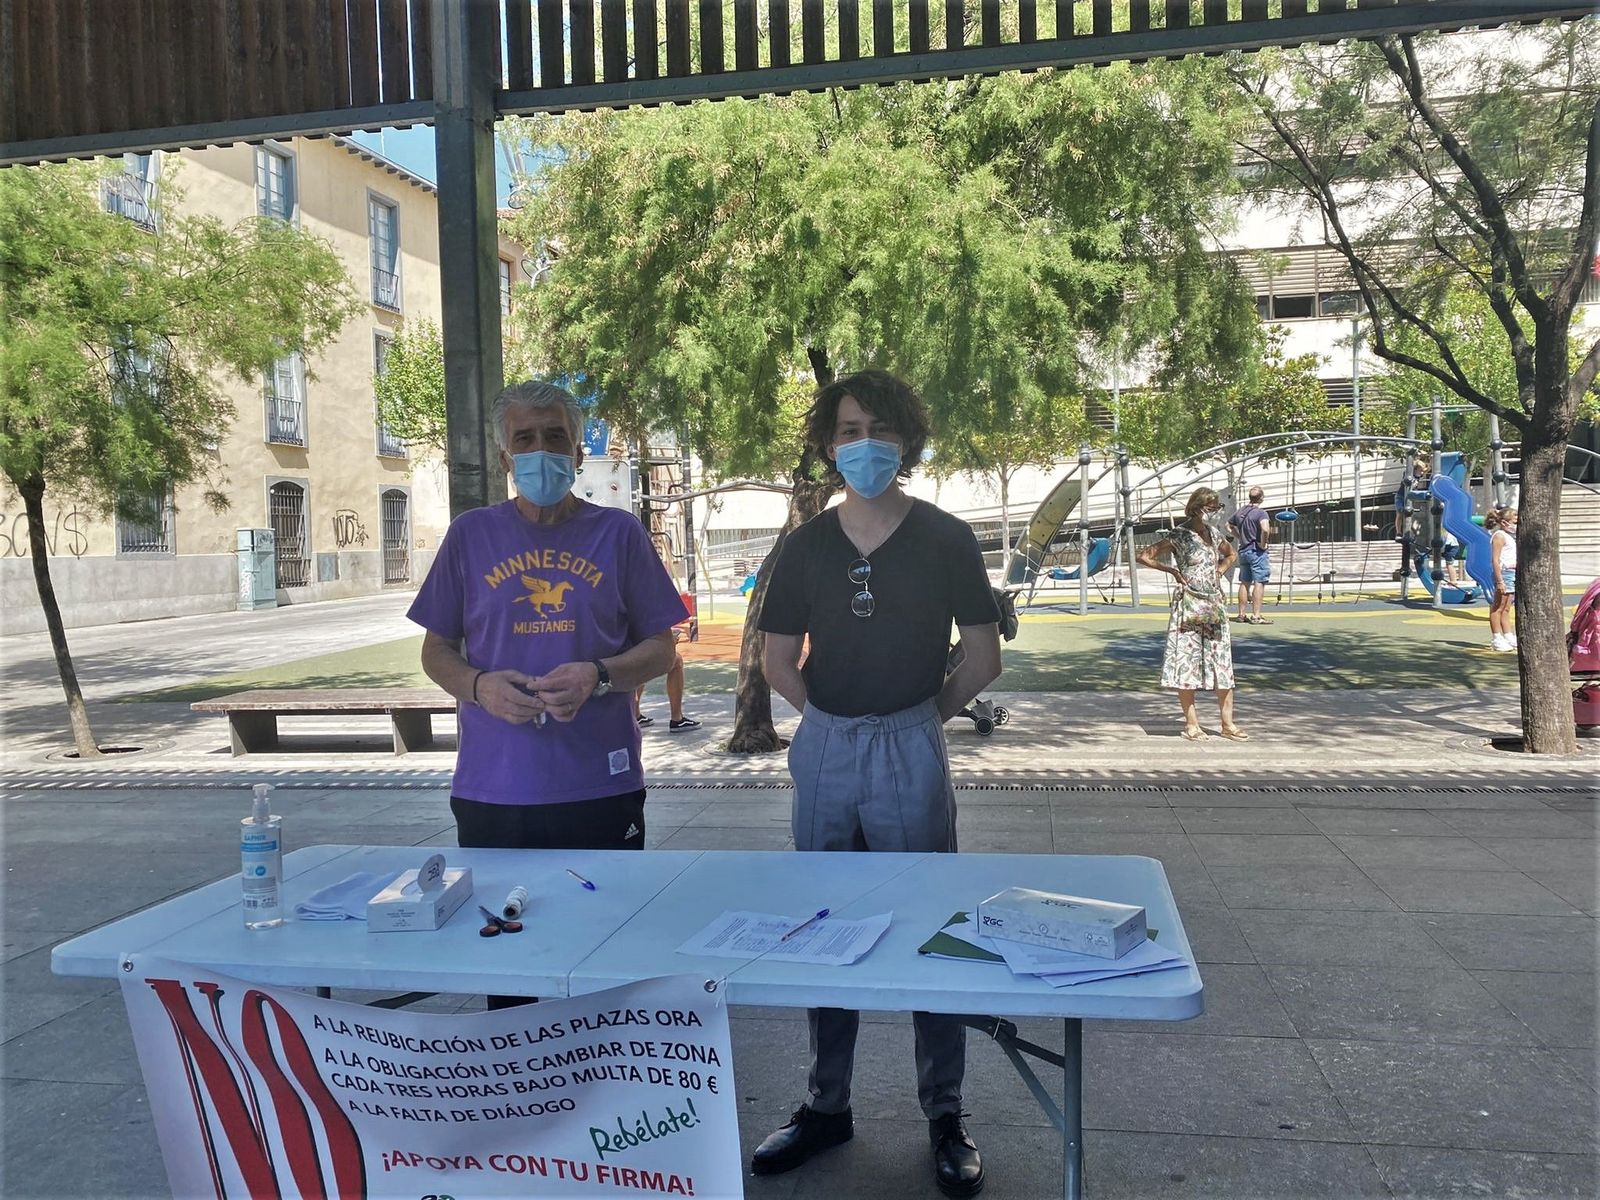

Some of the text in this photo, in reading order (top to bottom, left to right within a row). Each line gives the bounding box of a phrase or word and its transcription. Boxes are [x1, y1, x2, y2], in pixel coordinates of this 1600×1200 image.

[484, 549, 604, 589] MINNESOTA
[513, 620, 576, 634] MUSTANGS
[314, 1009, 702, 1053] A LA REUBICACIÓN DE LAS PLAZAS ORA
[325, 1041, 721, 1080] A LA OBLIGACIÓN DE CAMBIAR DE ZONA
[145, 978, 367, 1200] NO
[331, 1065, 718, 1099] CADA TRES HORAS BAJO MULTA DE 80 €
[348, 1098, 576, 1123] A LA FALTA DE DIÁLOGO
[590, 1097, 701, 1160] Rebélate!
[382, 1150, 695, 1197] ¡APOYA CON TU FIRMA!
